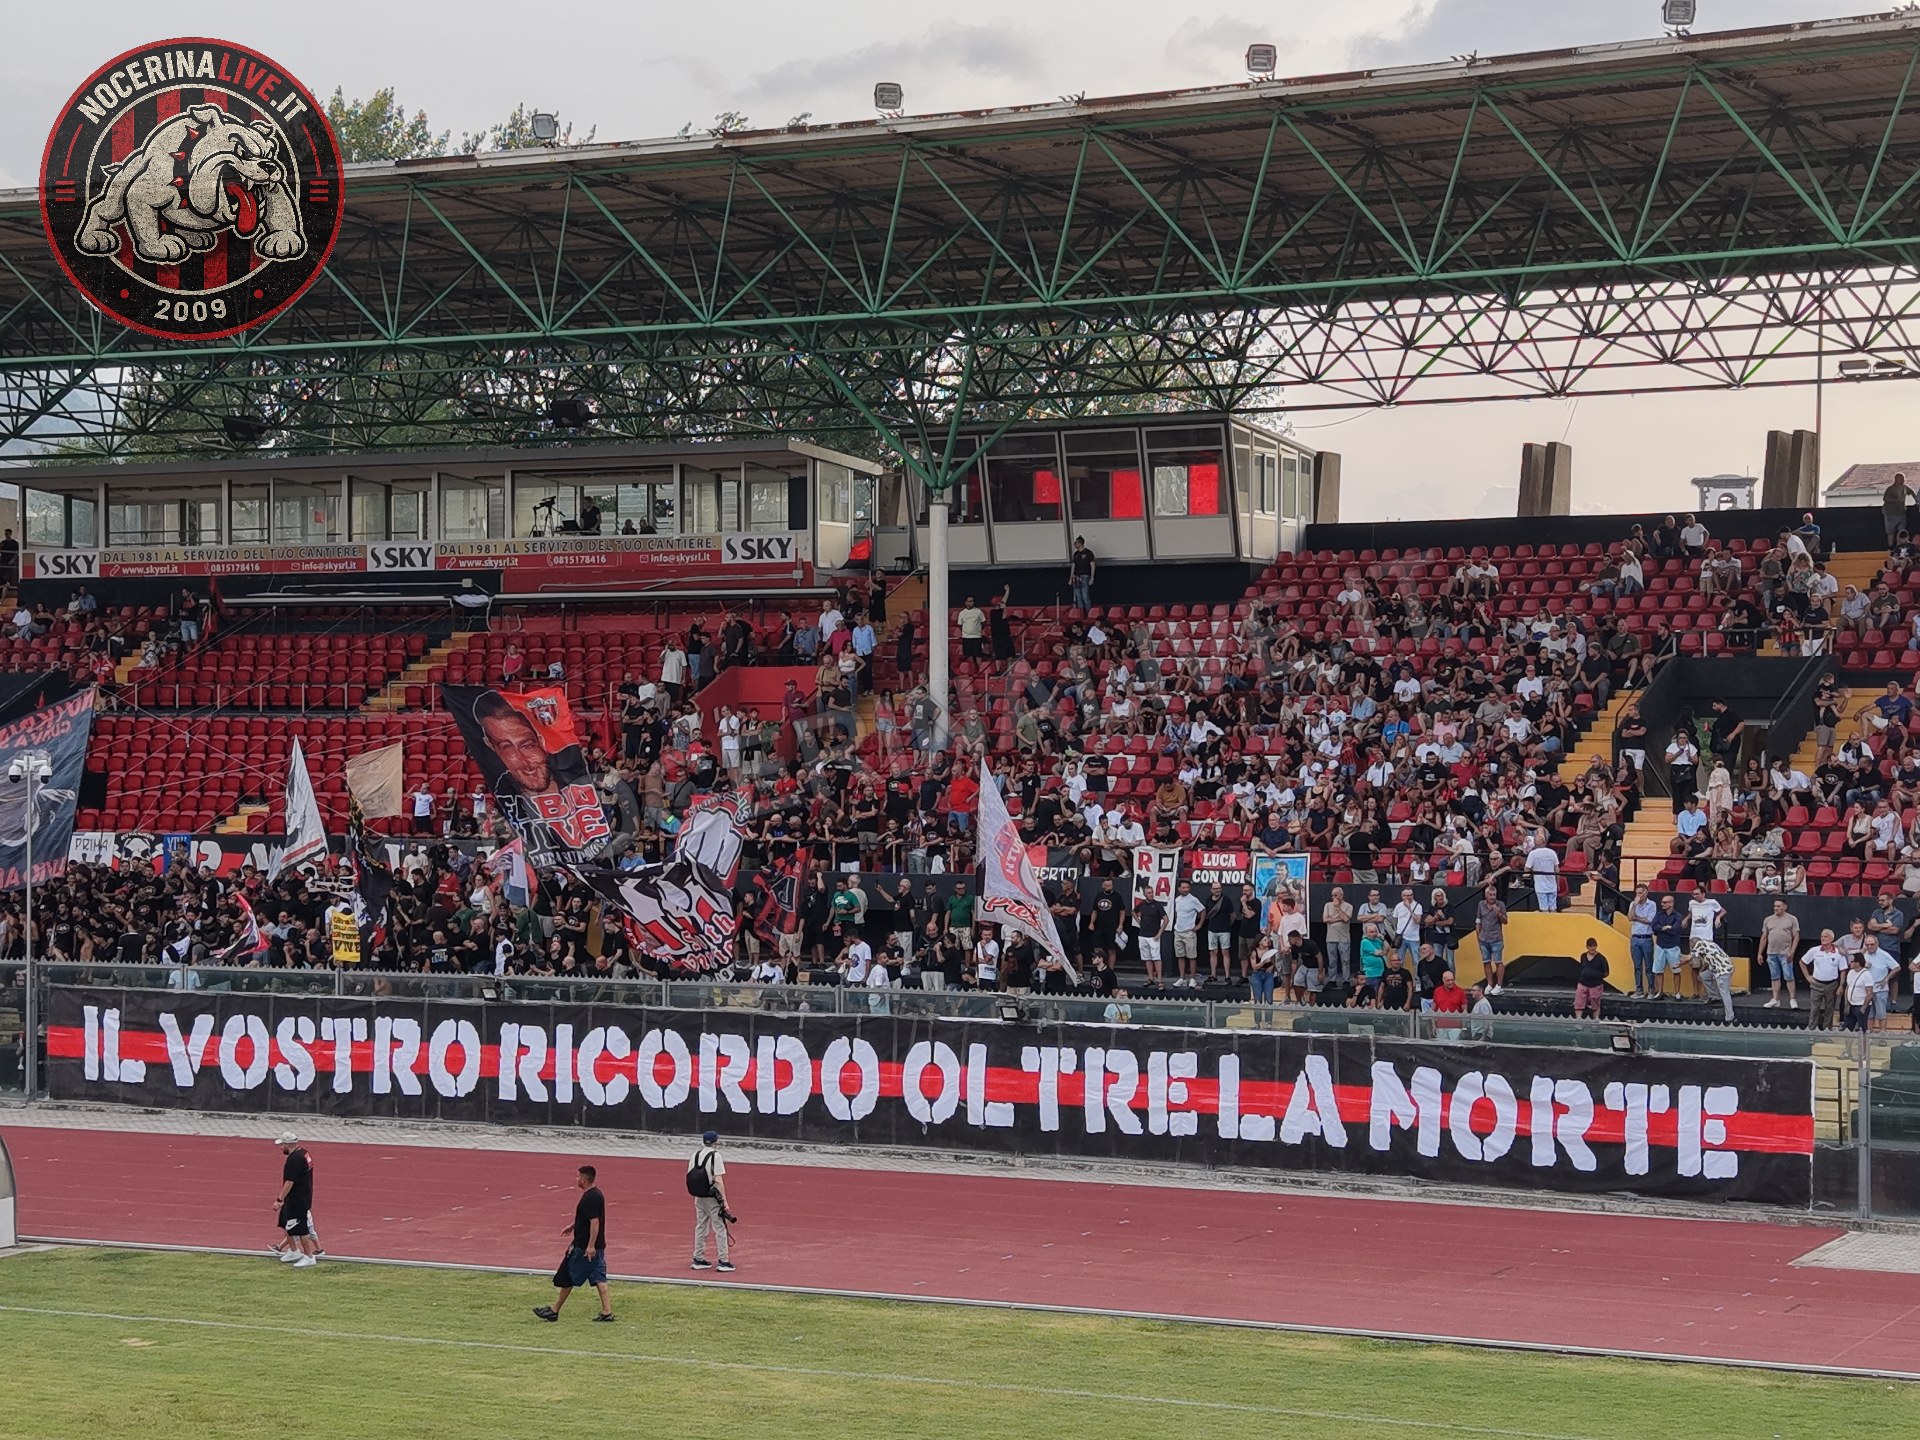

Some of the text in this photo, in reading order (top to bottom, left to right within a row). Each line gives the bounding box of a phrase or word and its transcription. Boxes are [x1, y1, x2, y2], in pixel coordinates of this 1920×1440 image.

[439, 545, 464, 555] DAL
[470, 544, 498, 554] 1981
[504, 543, 519, 554] AL
[524, 540, 583, 553] SERVIZIO
[589, 540, 613, 551] DEL
[615, 540, 642, 550] TUO
[741, 537, 792, 560] SKY
[103, 552, 126, 563] DAL
[132, 551, 159, 562] 1981
[164, 551, 178, 561] AL
[183, 549, 239, 561] SERVIZIO
[244, 549, 265, 560] DEL
[270, 548, 294, 559] TUO
[384, 547, 432, 568] SKY
[459, 556, 519, 568] www.skysrl.it
[553, 555, 607, 565] 0815178416
[52, 554, 96, 575] SKY
[122, 564, 179, 575] www.skysrl.it
[496, 784, 599, 822] FABIO
[1202, 853, 1237, 867] LUCA
[1192, 870, 1246, 884] CON NOI
[83, 1005, 1739, 1180] IL VOSTRO RICORDO OLTRE LA MORTE
